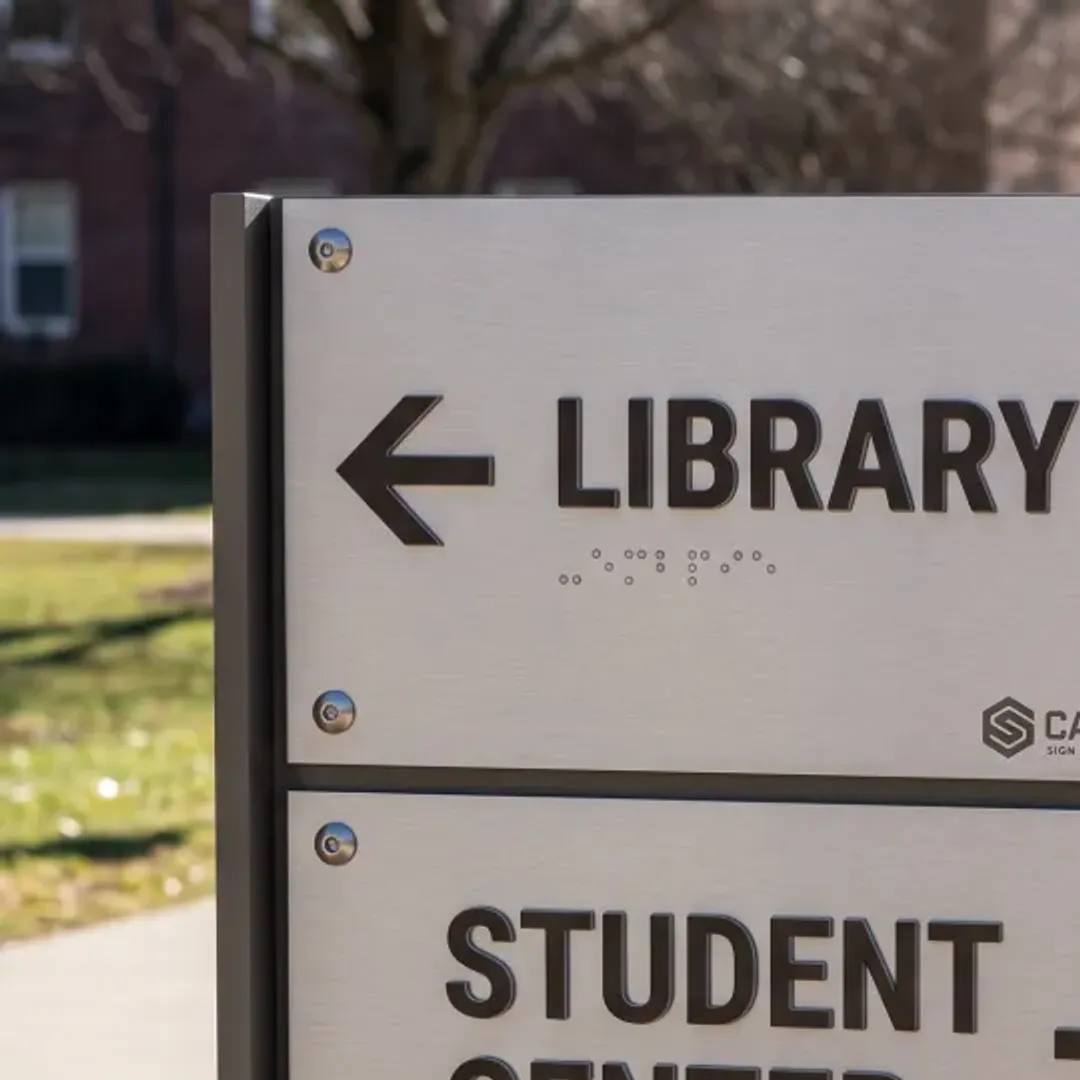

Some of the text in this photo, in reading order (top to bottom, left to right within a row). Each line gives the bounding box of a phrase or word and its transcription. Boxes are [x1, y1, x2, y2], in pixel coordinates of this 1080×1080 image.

[557, 396, 1080, 514] LIBRARY
[1046, 745, 1076, 756] SIGN
[445, 905, 1004, 1035] STUDENT
